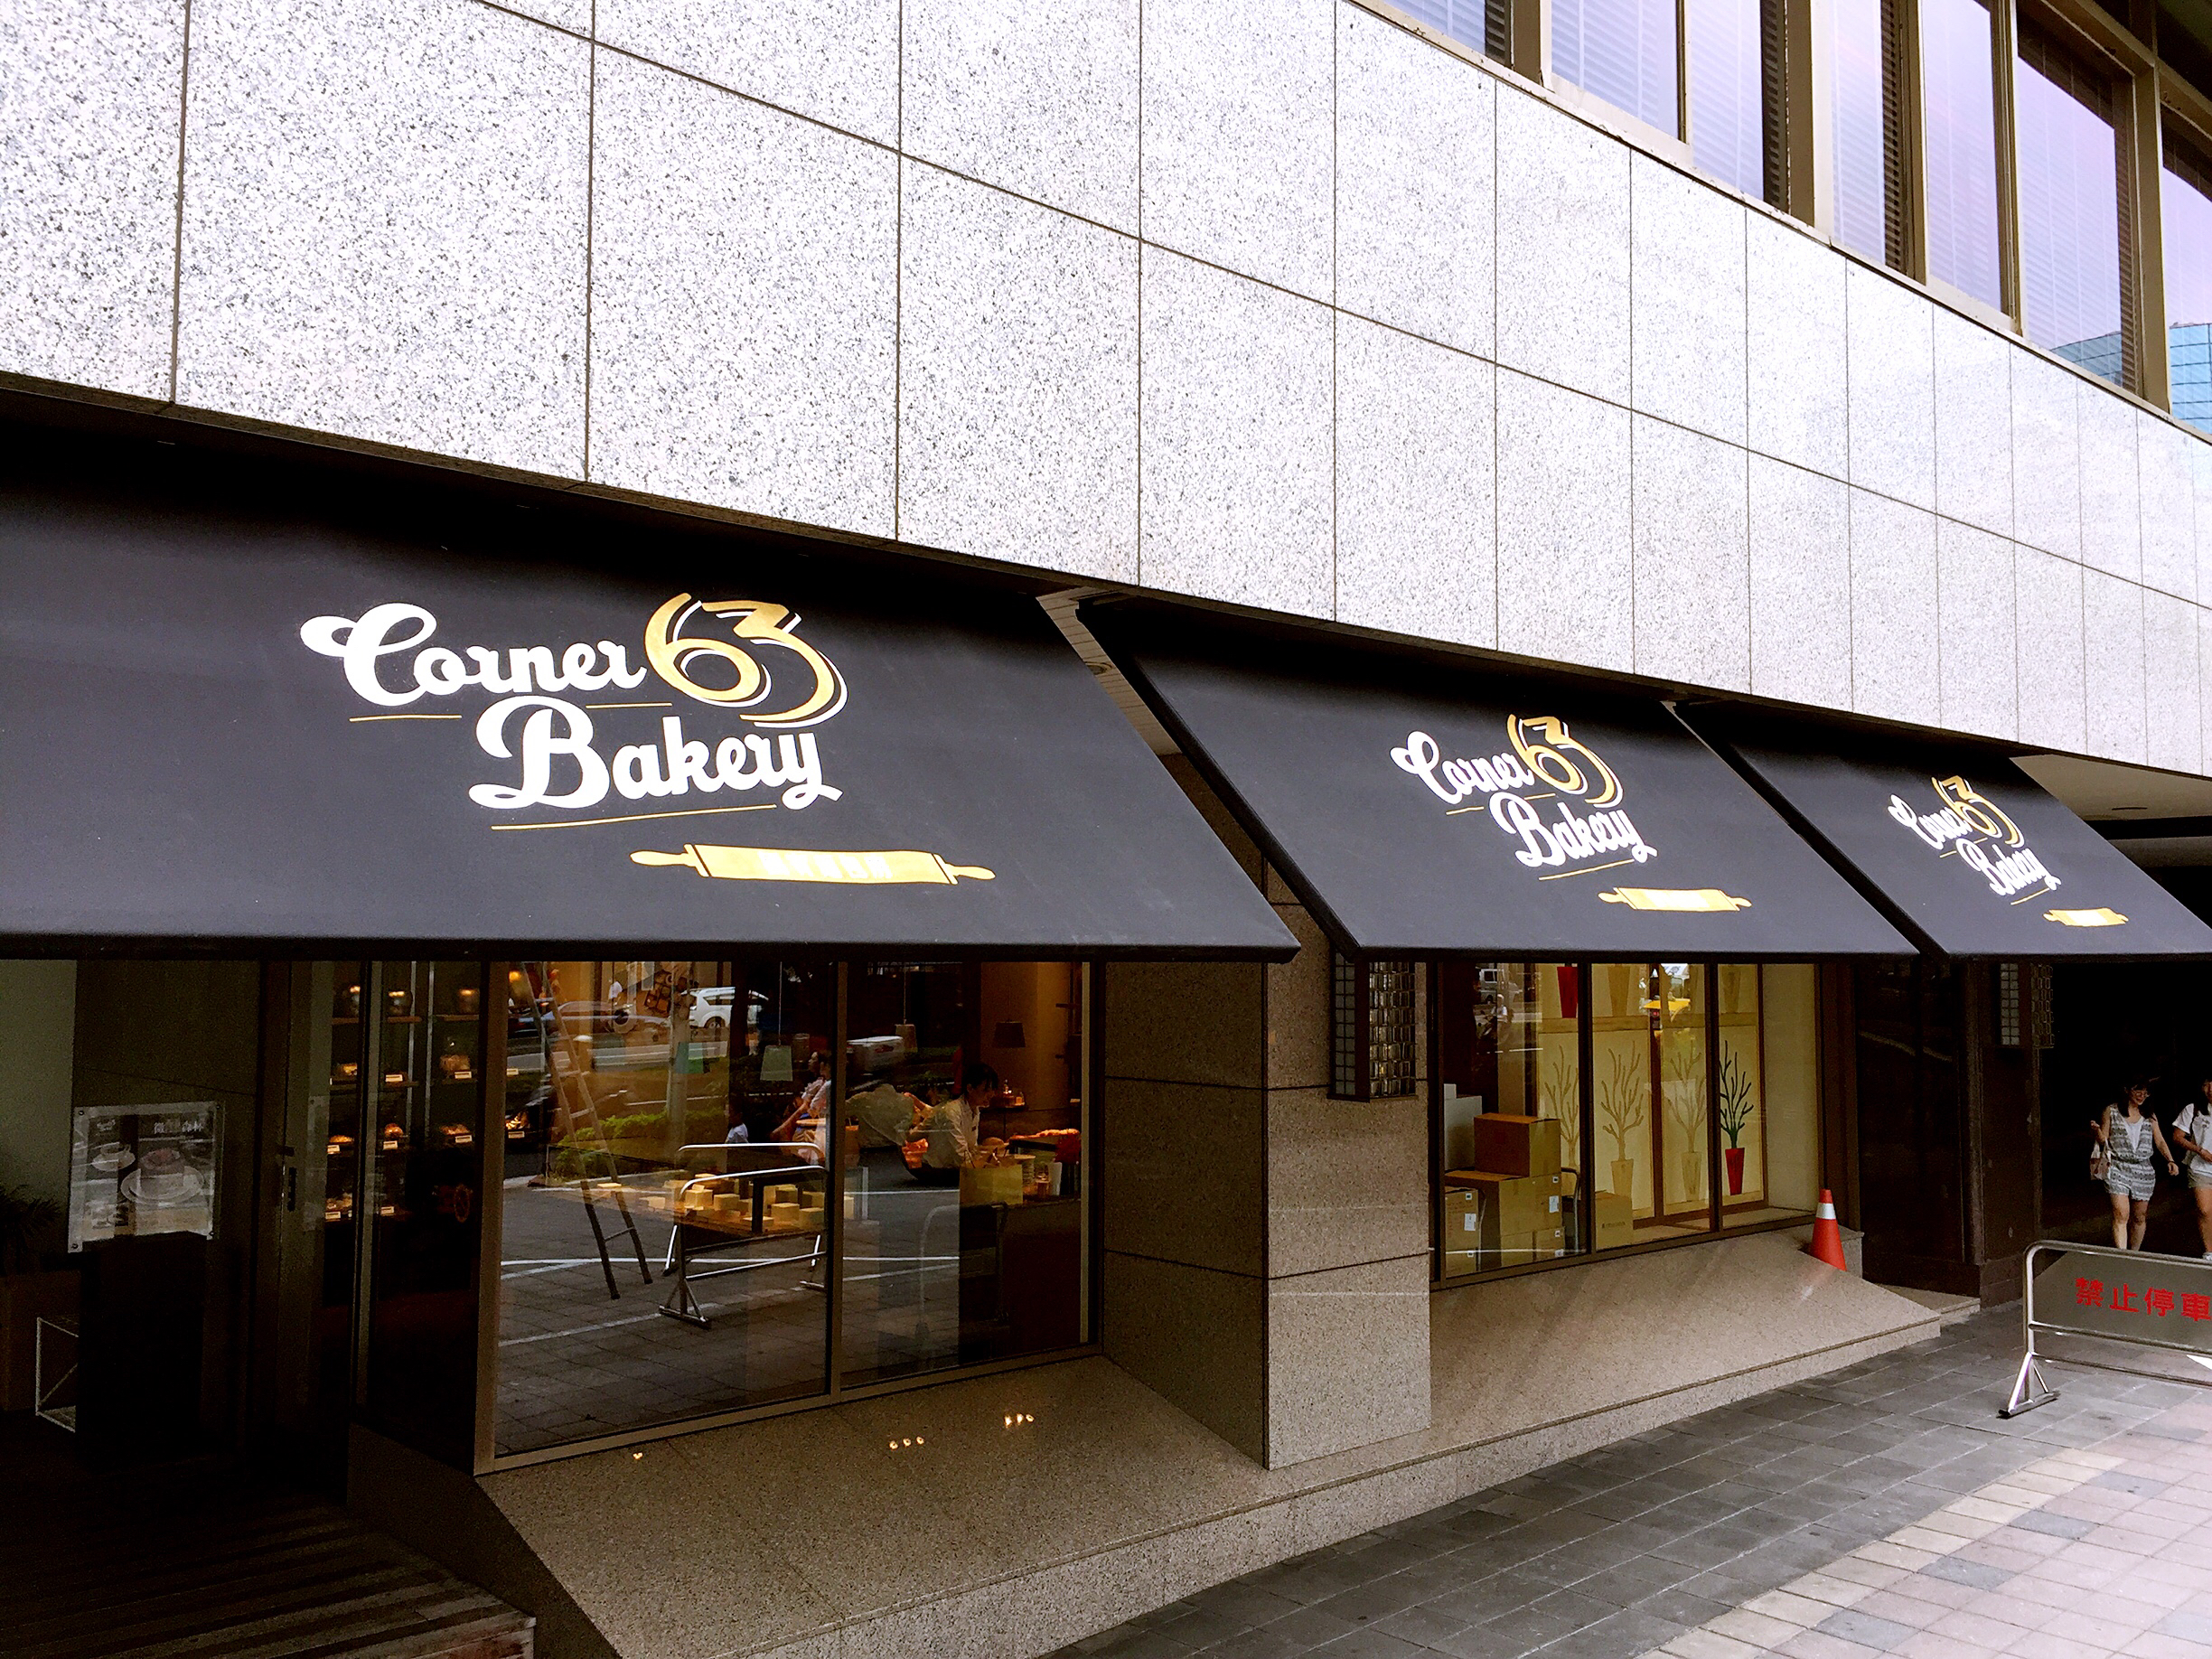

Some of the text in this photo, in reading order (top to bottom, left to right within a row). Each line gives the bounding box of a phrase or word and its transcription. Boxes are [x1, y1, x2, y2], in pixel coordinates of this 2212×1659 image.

[300, 593, 848, 728] Corner 63
[469, 695, 843, 810] Bakery
[1391, 713, 1624, 809] Corner 63
[1489, 792, 1658, 867] Bakery
[1888, 775, 2025, 850] Corner 63
[1955, 838, 2062, 896] Bakery
[2076, 1277, 2211, 1322] 禁止停車
